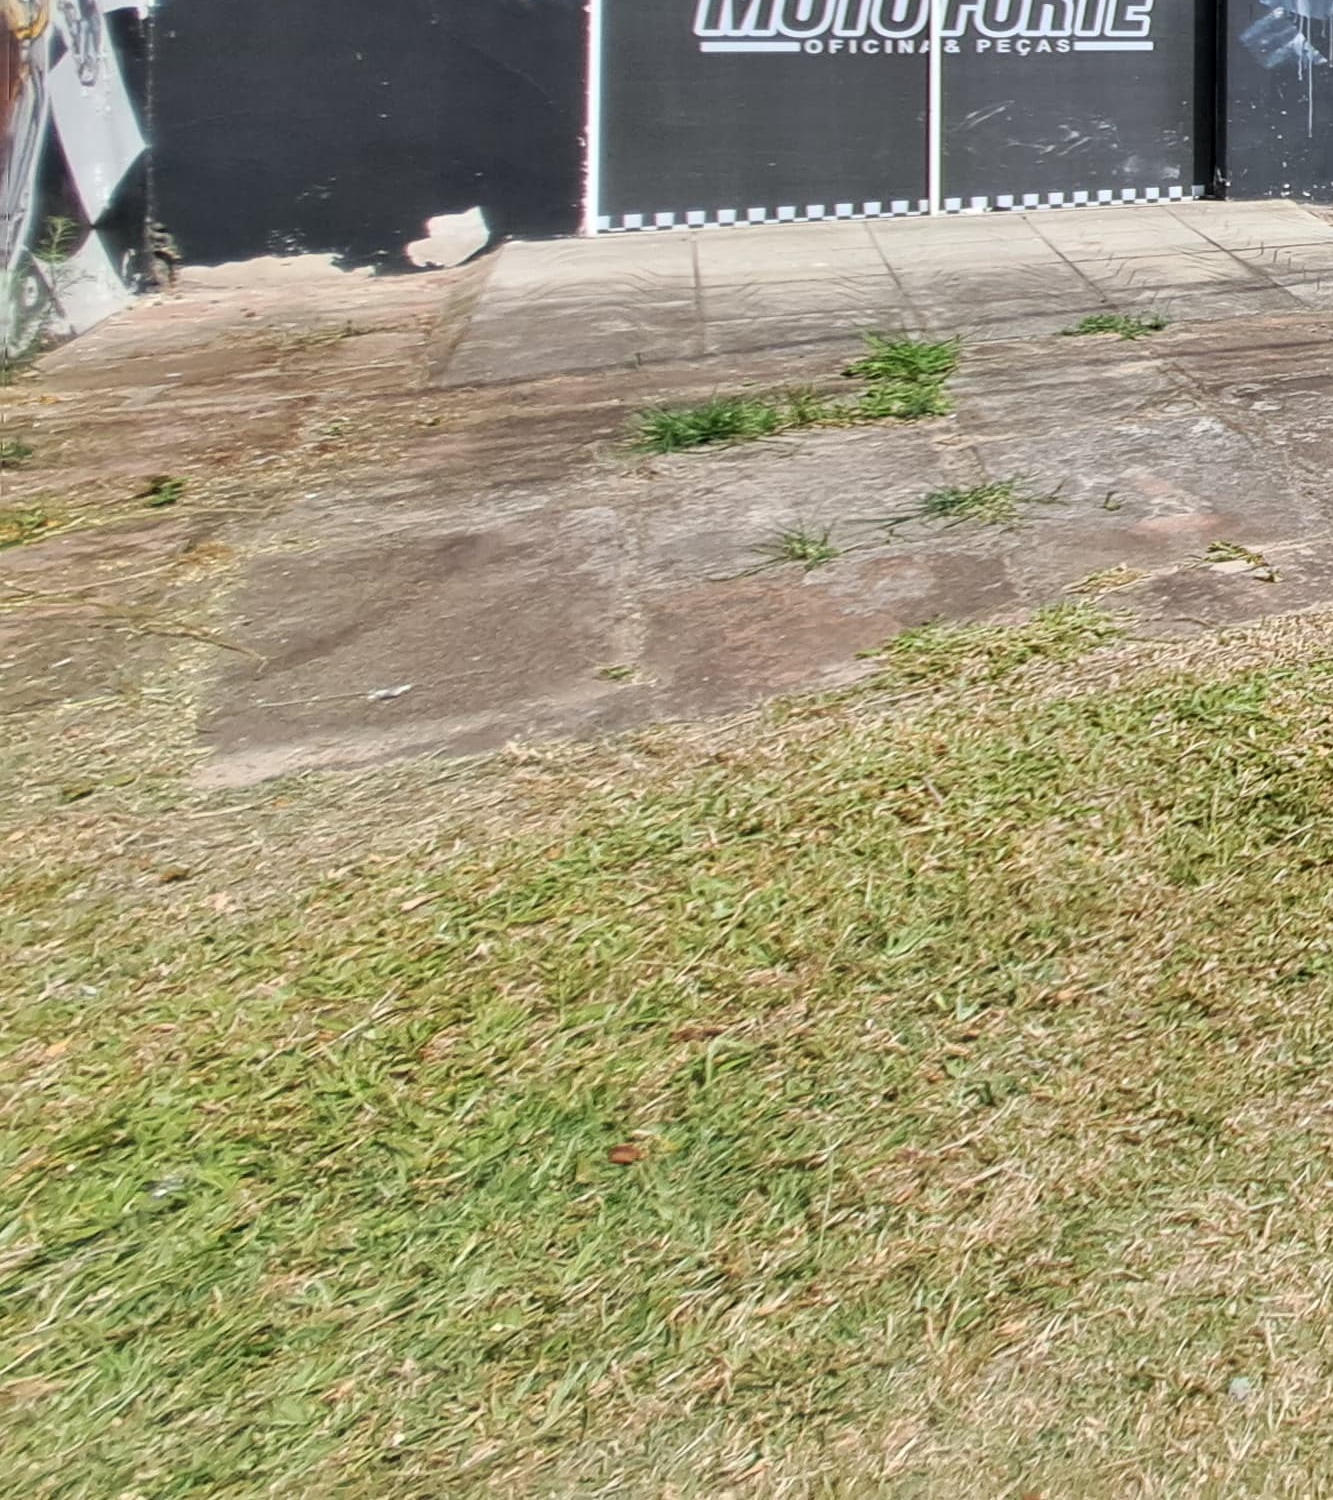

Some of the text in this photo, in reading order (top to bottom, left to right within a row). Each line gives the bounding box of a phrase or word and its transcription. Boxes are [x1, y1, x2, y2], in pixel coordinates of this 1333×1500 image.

[803, 39, 1071, 56] OFICINA & PEÇAS
